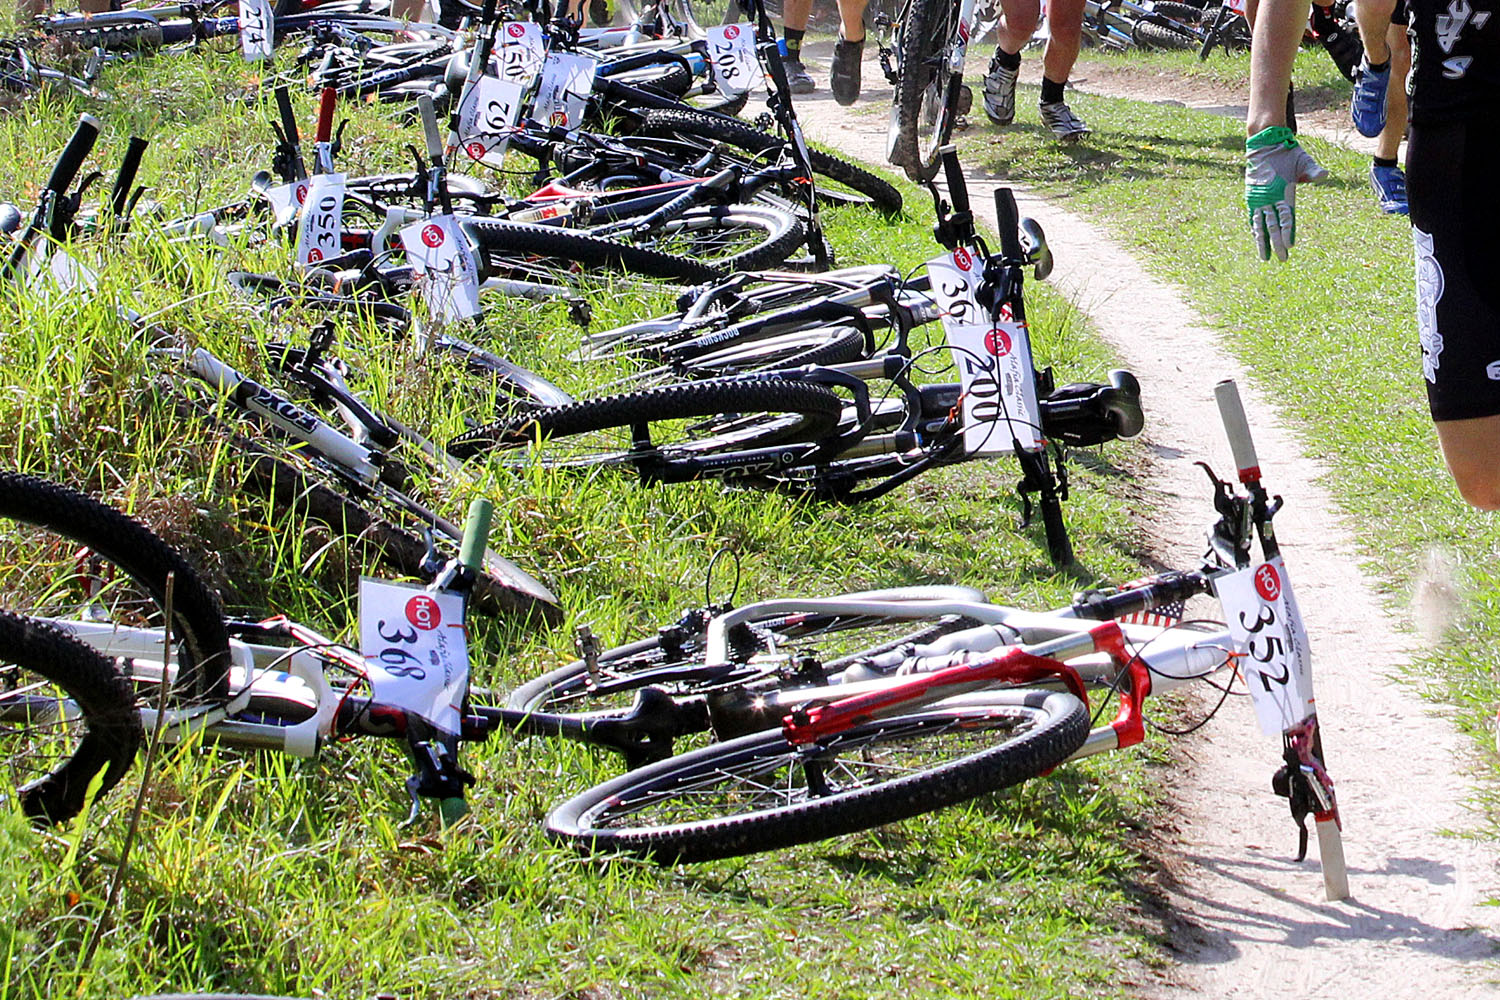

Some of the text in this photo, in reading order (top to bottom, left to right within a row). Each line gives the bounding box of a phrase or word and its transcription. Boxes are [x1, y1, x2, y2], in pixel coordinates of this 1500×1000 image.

[243, 6, 265, 43] 274
[715, 41, 740, 80] 208
[317, 196, 337, 248] 350
[956, 250, 972, 271] HOT
[942, 278, 976, 325] 36
[965, 355, 1002, 422] 200
[1257, 566, 1279, 598] HOT
[415, 597, 432, 628] HOT
[378, 619, 426, 680] 368
[1239, 604, 1290, 692] 352
